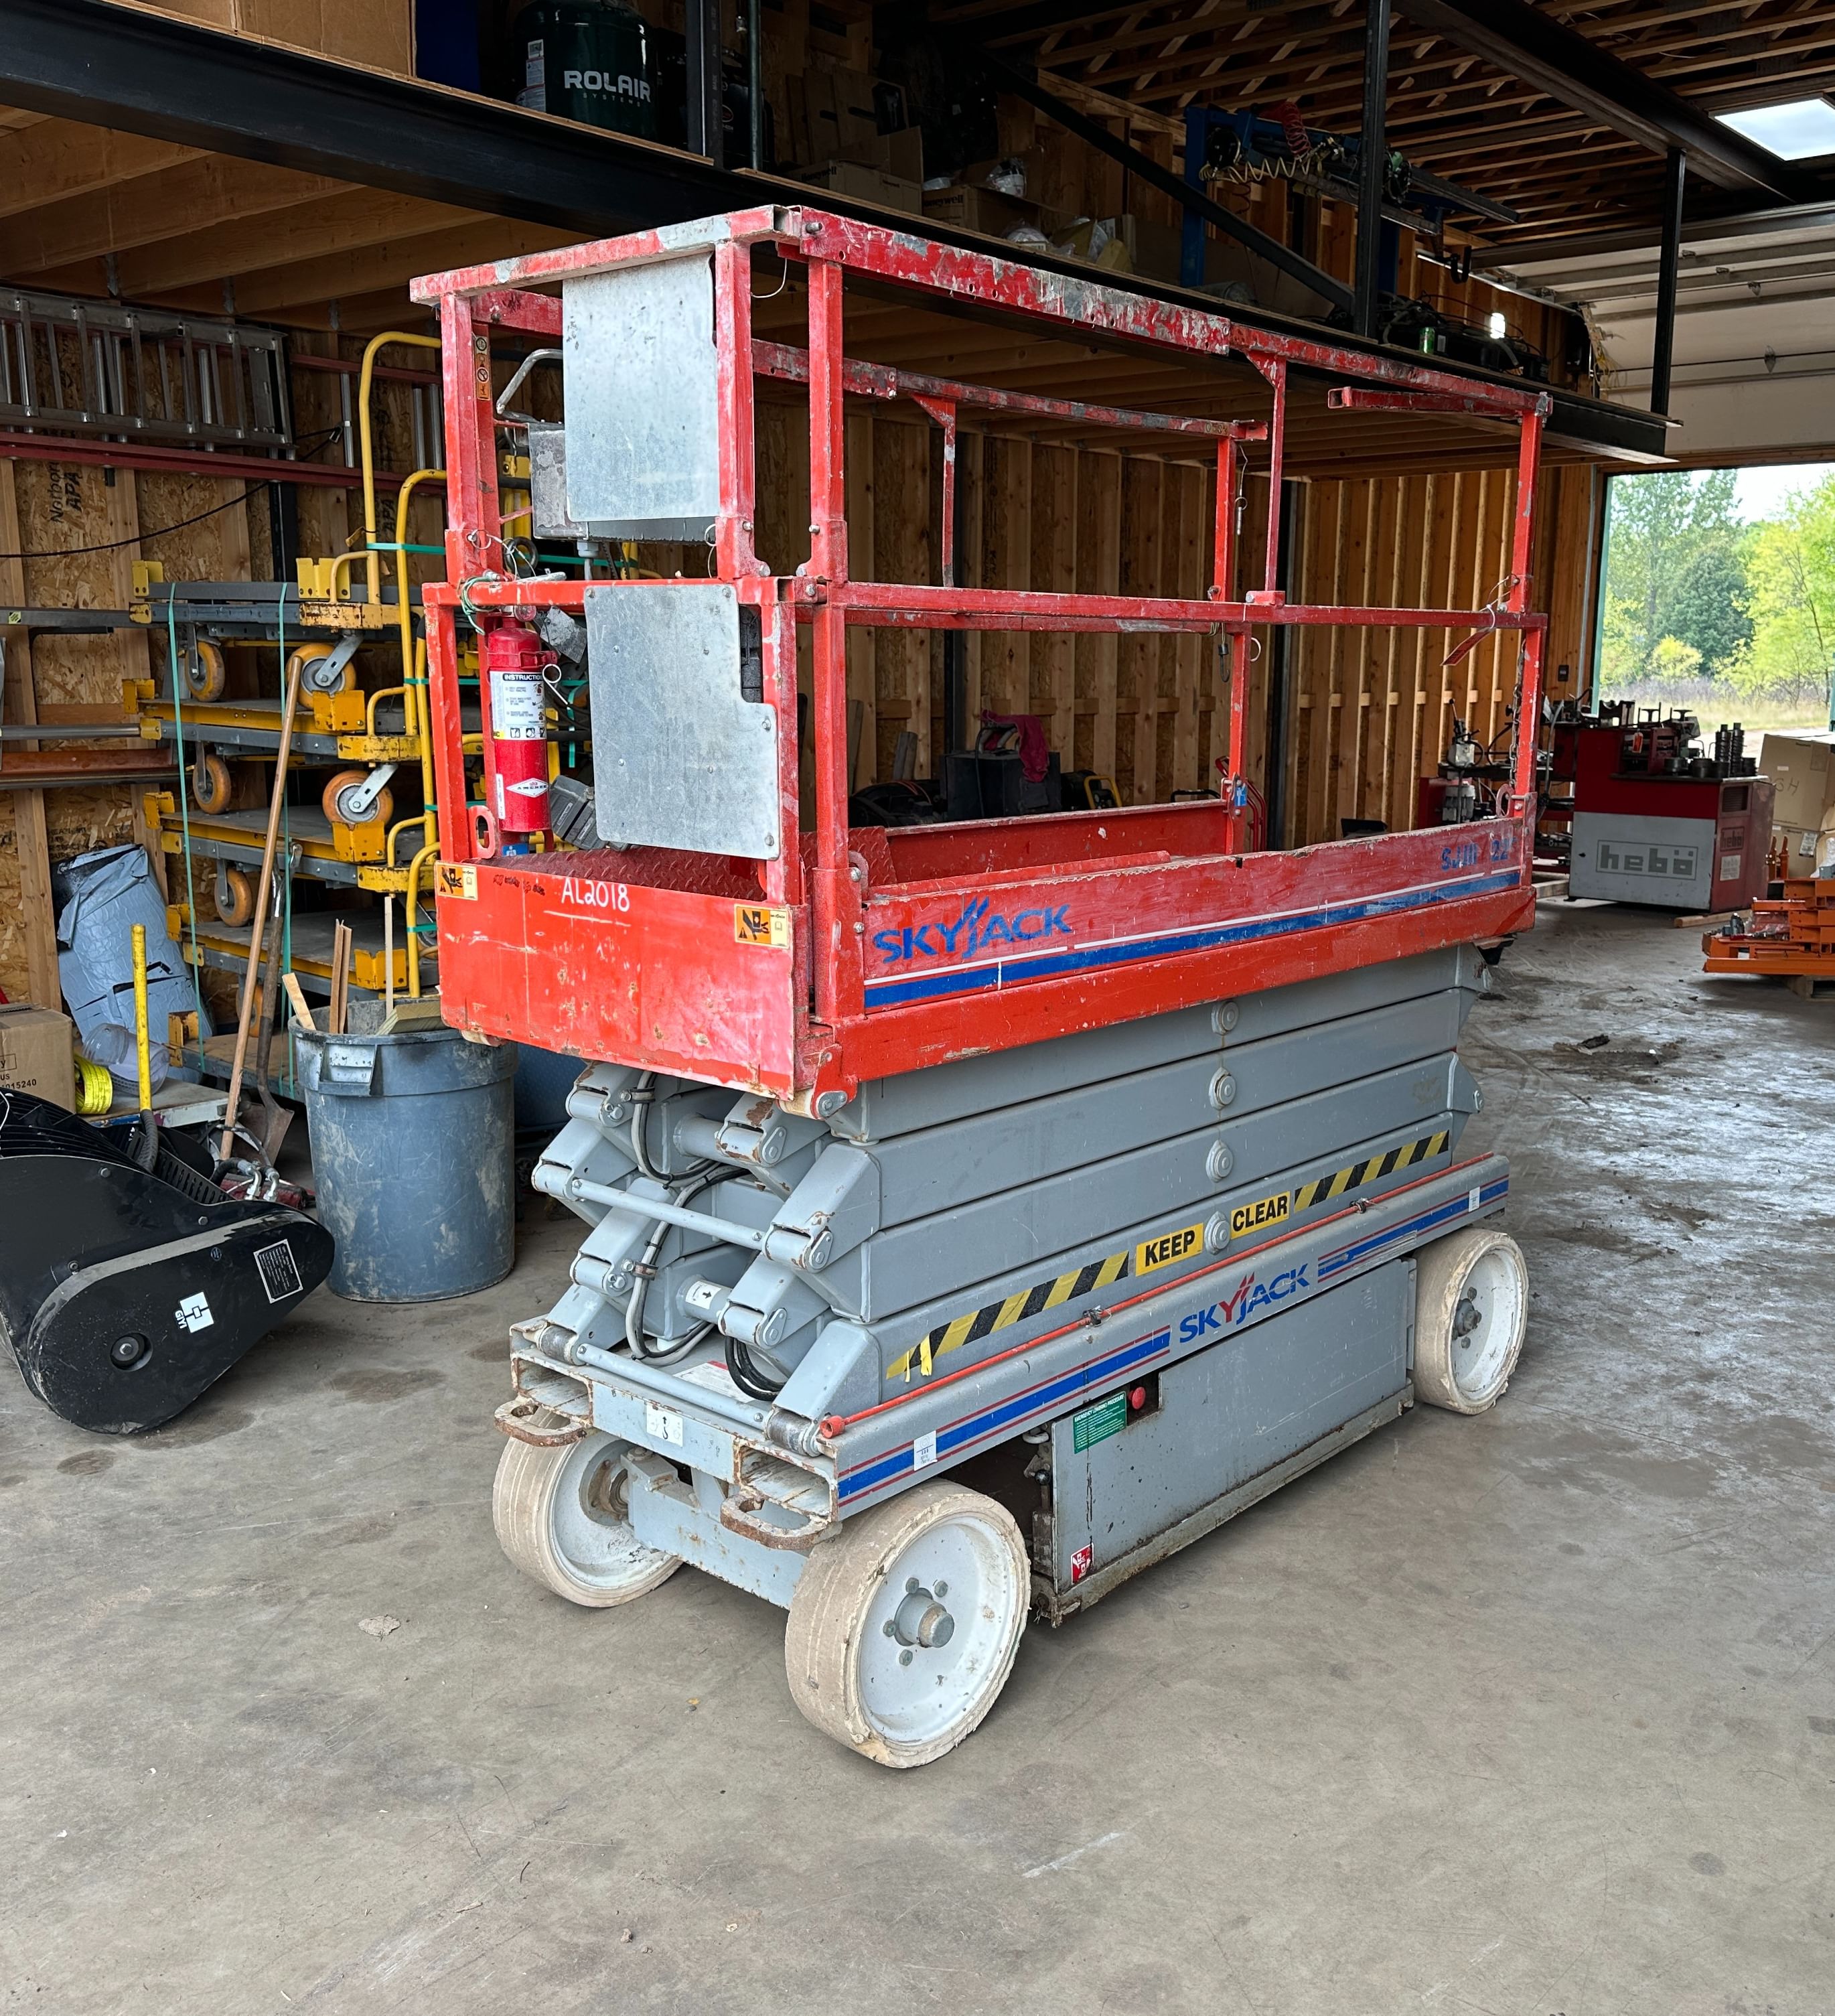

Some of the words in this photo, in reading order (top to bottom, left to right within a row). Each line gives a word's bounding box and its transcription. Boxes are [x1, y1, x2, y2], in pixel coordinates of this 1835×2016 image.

[563, 70, 652, 103] ROLAIR
[47, 461, 64, 523] Norbor
[64, 472, 82, 512] APA
[561, 877, 630, 912] AL2018
[873, 895, 1072, 964] SKYJACK
[2, 1078, 37, 1090] 015240
[1145, 1230, 1195, 1267] KEEP
[1232, 1195, 1288, 1232] CLEAR
[1179, 1263, 1310, 1343] SKYJACK
